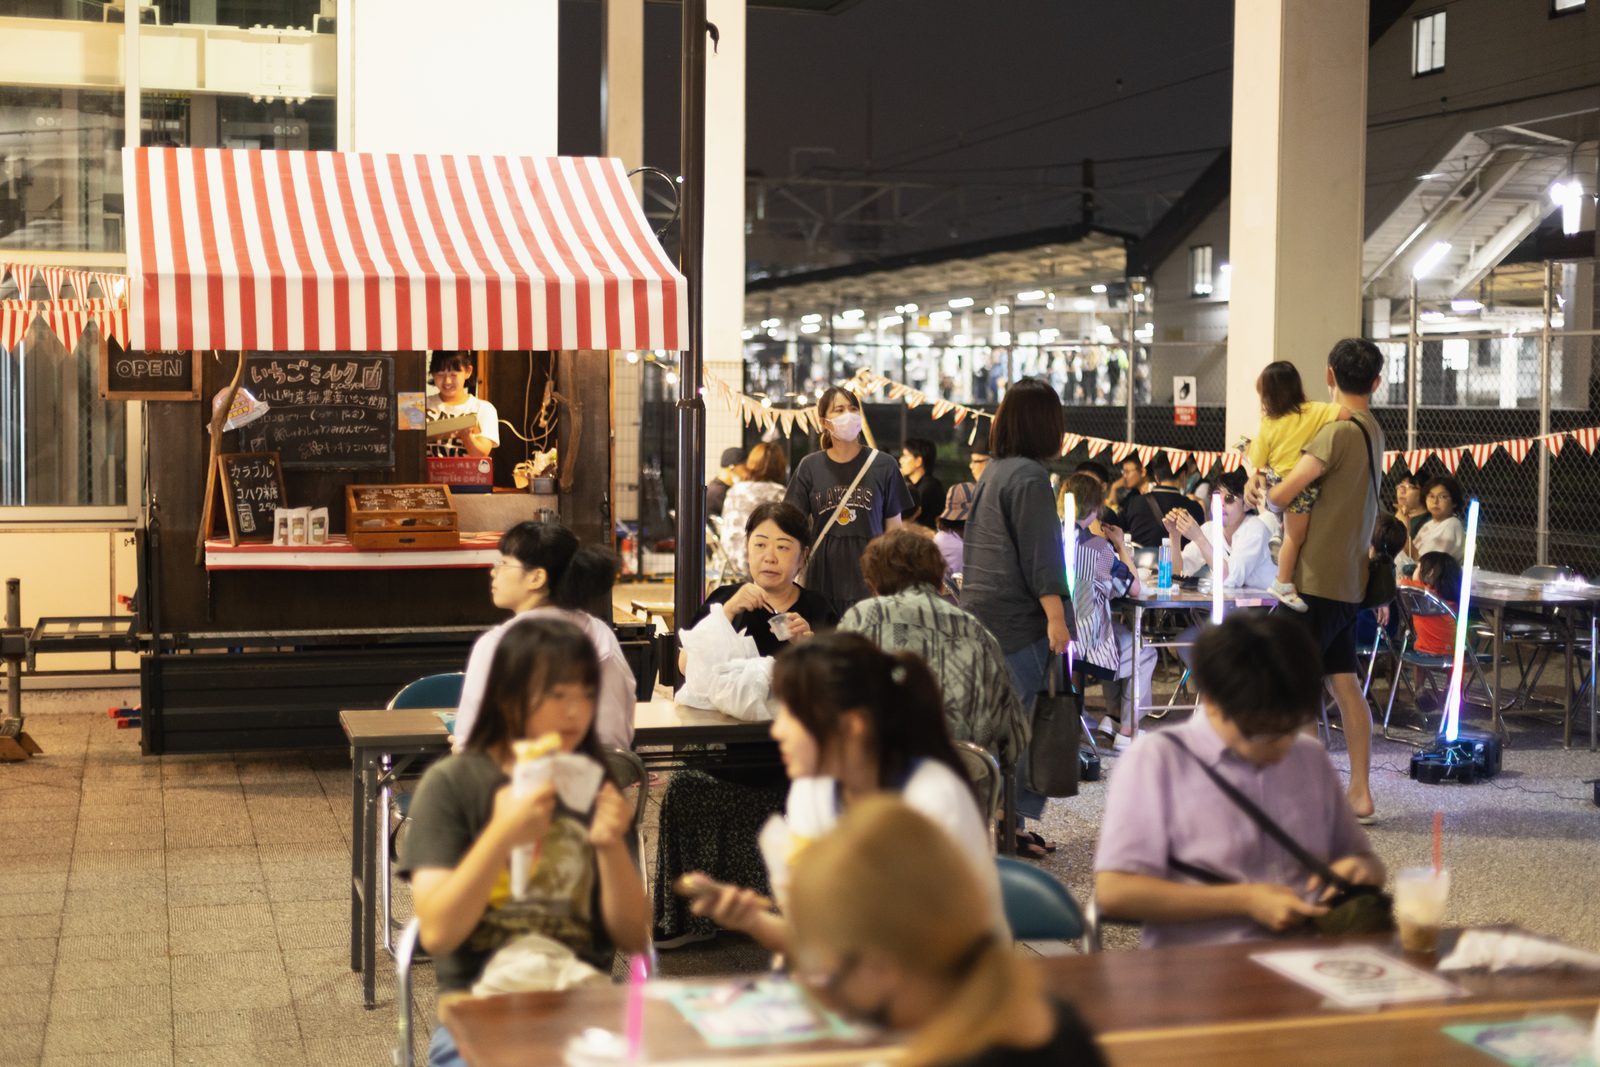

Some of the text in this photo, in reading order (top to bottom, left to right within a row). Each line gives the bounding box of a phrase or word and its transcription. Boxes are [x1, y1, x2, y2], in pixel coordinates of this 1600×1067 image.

[116, 360, 183, 377] OPEN
[251, 360, 358, 385] いちごミルク
[231, 464, 274, 478] カラフル
[236, 485, 279, 501] コハク糖
